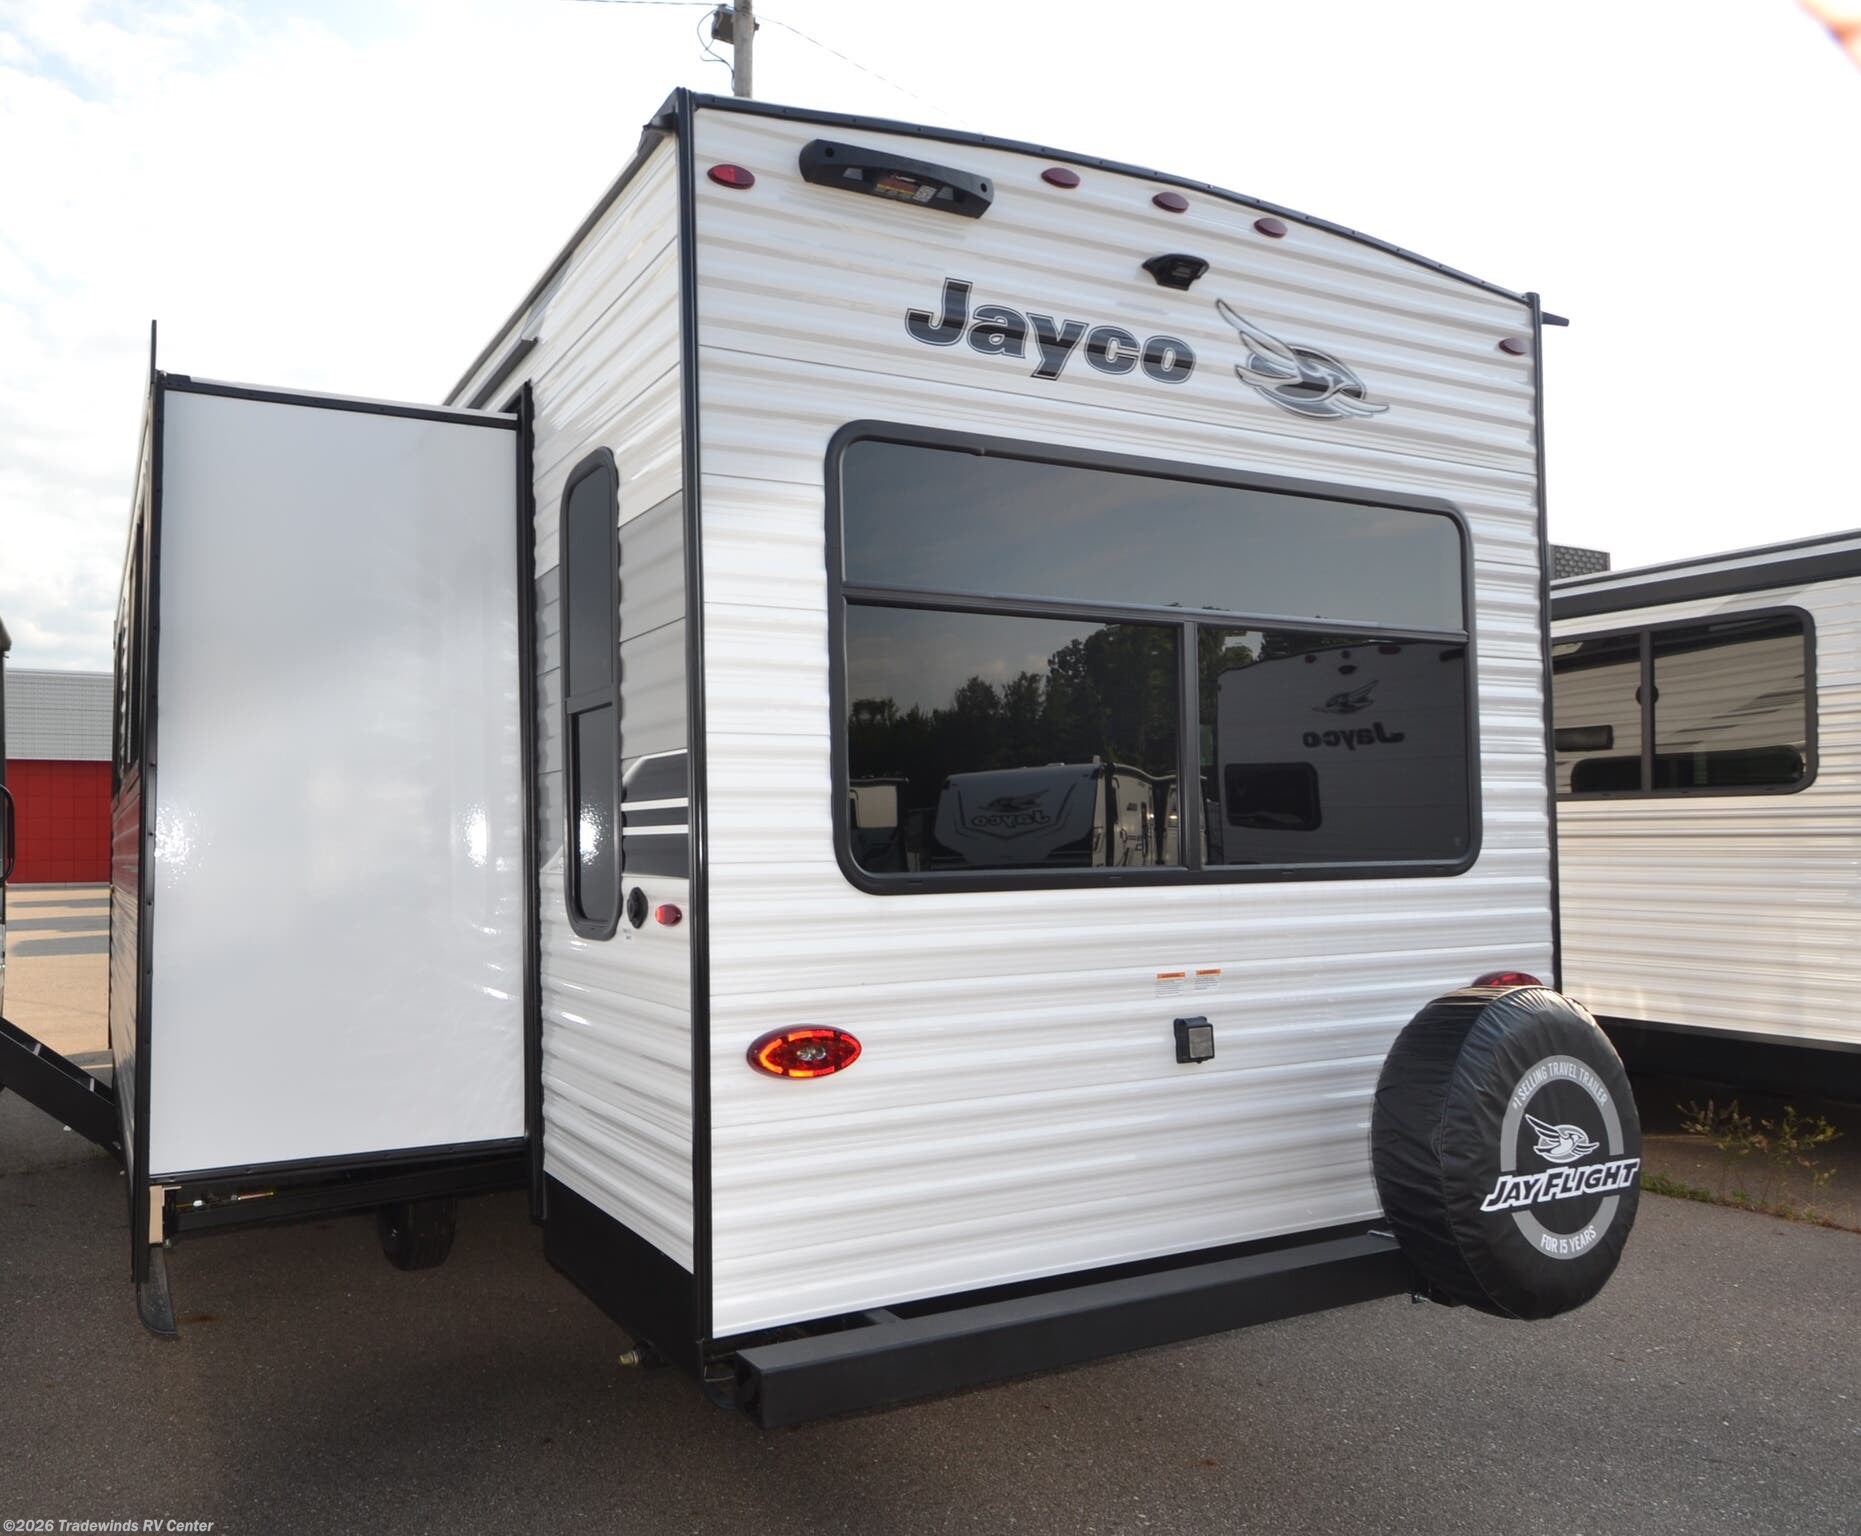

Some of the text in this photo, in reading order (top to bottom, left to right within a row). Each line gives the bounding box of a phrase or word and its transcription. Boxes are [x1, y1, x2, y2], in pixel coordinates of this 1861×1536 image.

[905, 277, 1197, 381] Jayco
[1518, 1066, 1548, 1101] SELLING
[1547, 1061, 1577, 1079] TRAVEL
[1579, 1067, 1608, 1107] TRAILER
[1541, 1225, 1597, 1254] FOR 15 YEARS
